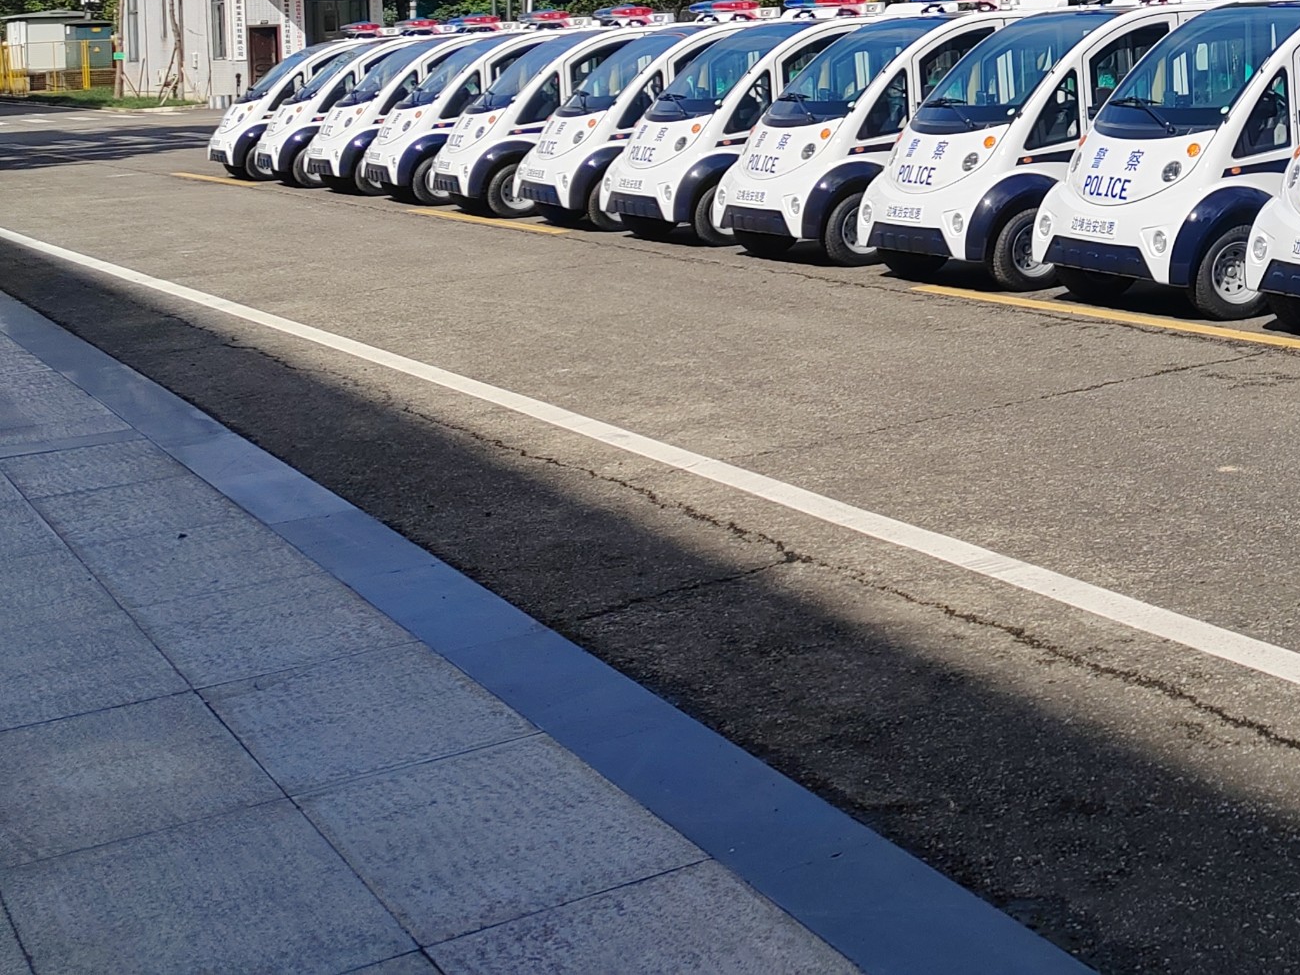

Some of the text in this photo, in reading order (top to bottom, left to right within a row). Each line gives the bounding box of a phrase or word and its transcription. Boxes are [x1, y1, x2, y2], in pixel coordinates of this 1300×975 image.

[747, 153, 780, 174] POLICE
[1091, 147, 1145, 172] 警察
[897, 164, 936, 186] POLICE
[1083, 175, 1131, 200] POLICE
